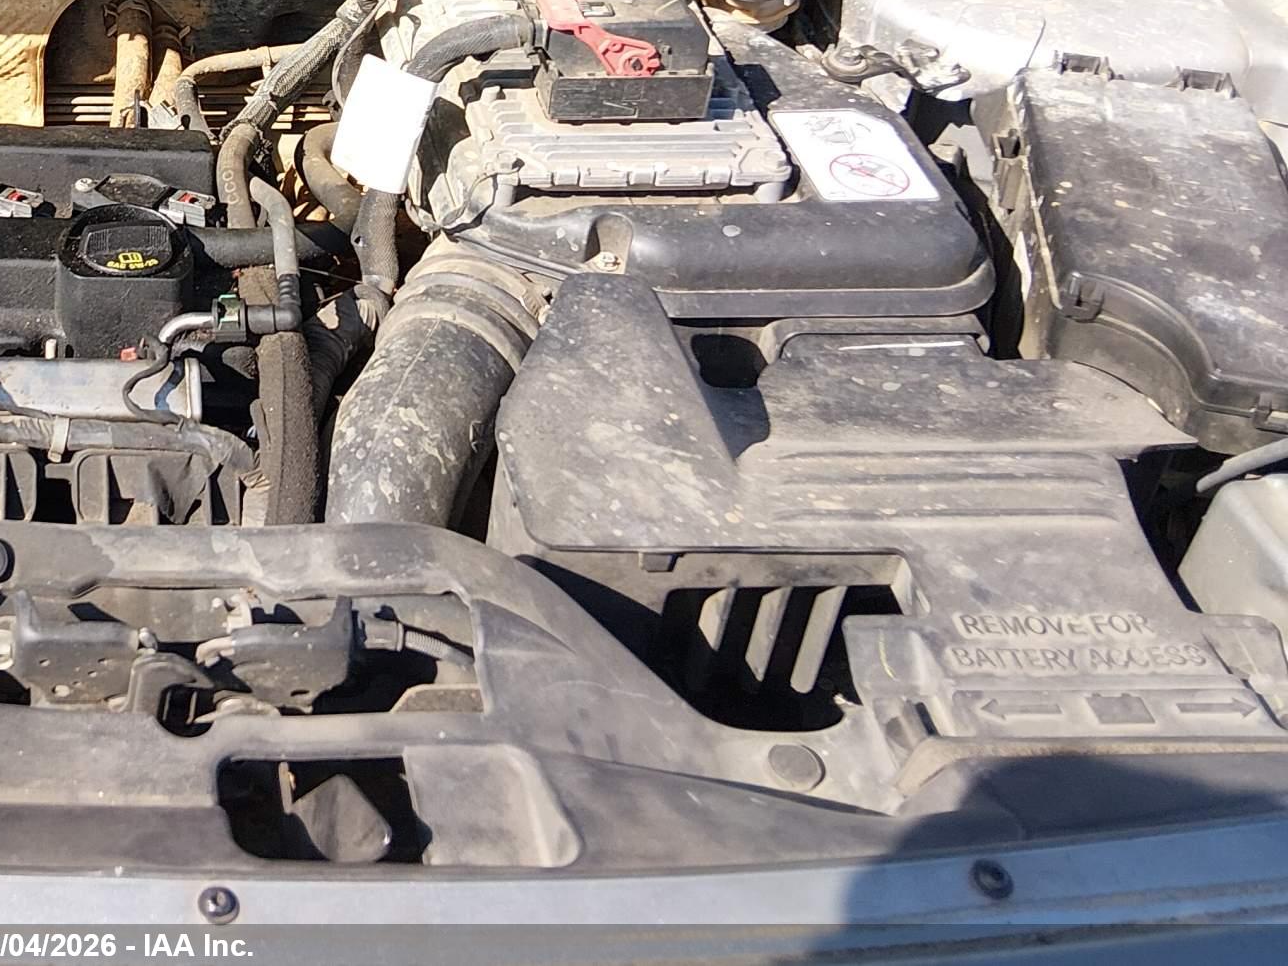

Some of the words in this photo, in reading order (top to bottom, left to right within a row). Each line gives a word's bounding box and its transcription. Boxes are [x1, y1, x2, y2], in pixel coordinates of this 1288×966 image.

[958, 613, 1089, 636] REMOVE
[1089, 613, 1154, 635] FOR
[951, 646, 1079, 671] BATTERY
[1088, 643, 1208, 668] ACCESS
